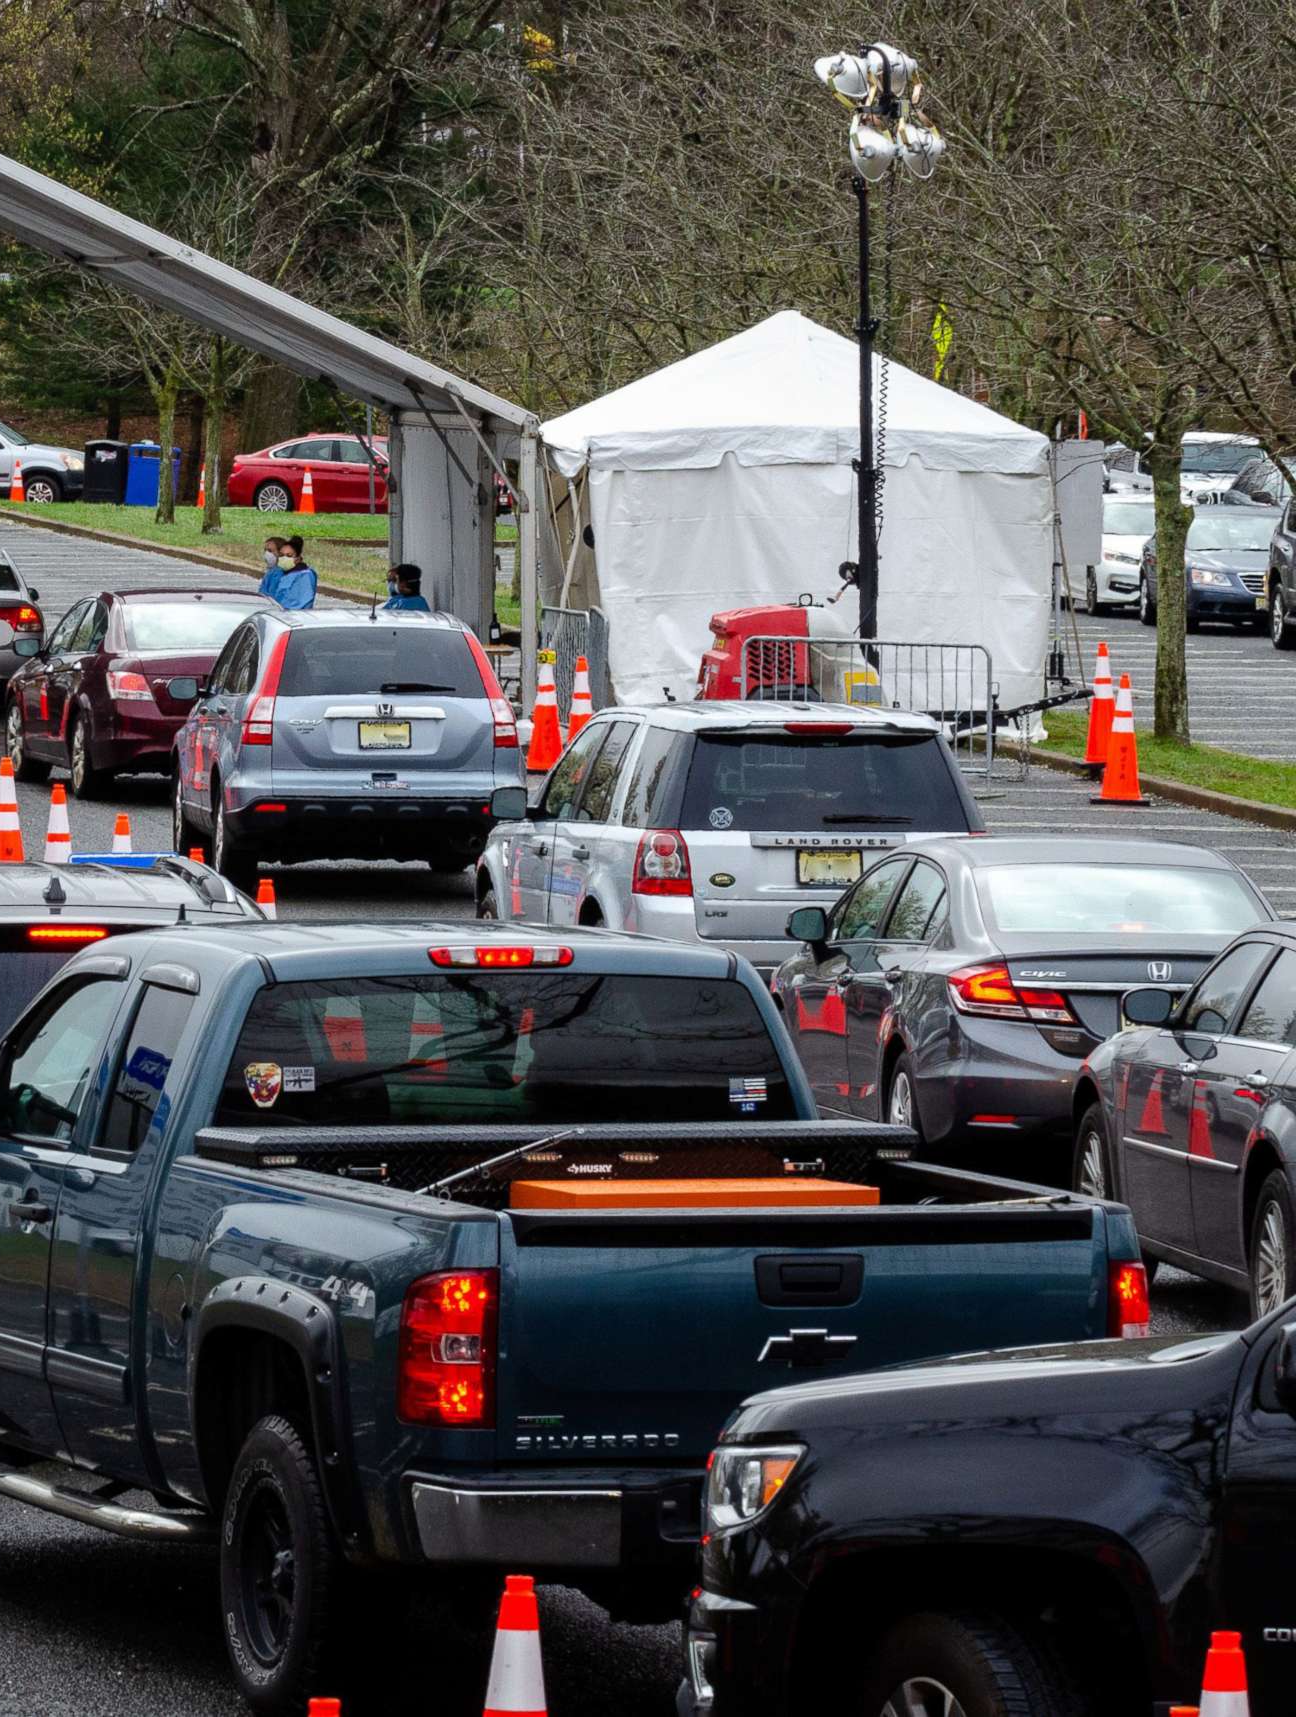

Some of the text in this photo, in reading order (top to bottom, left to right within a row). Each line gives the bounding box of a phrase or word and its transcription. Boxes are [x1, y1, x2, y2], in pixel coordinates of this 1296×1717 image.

[775, 838, 888, 846] LAND ROVER
[579, 1164, 613, 1173] HUSKY
[516, 1434, 679, 1449] SILVERADO
[1263, 1627, 1296, 1642] CO
